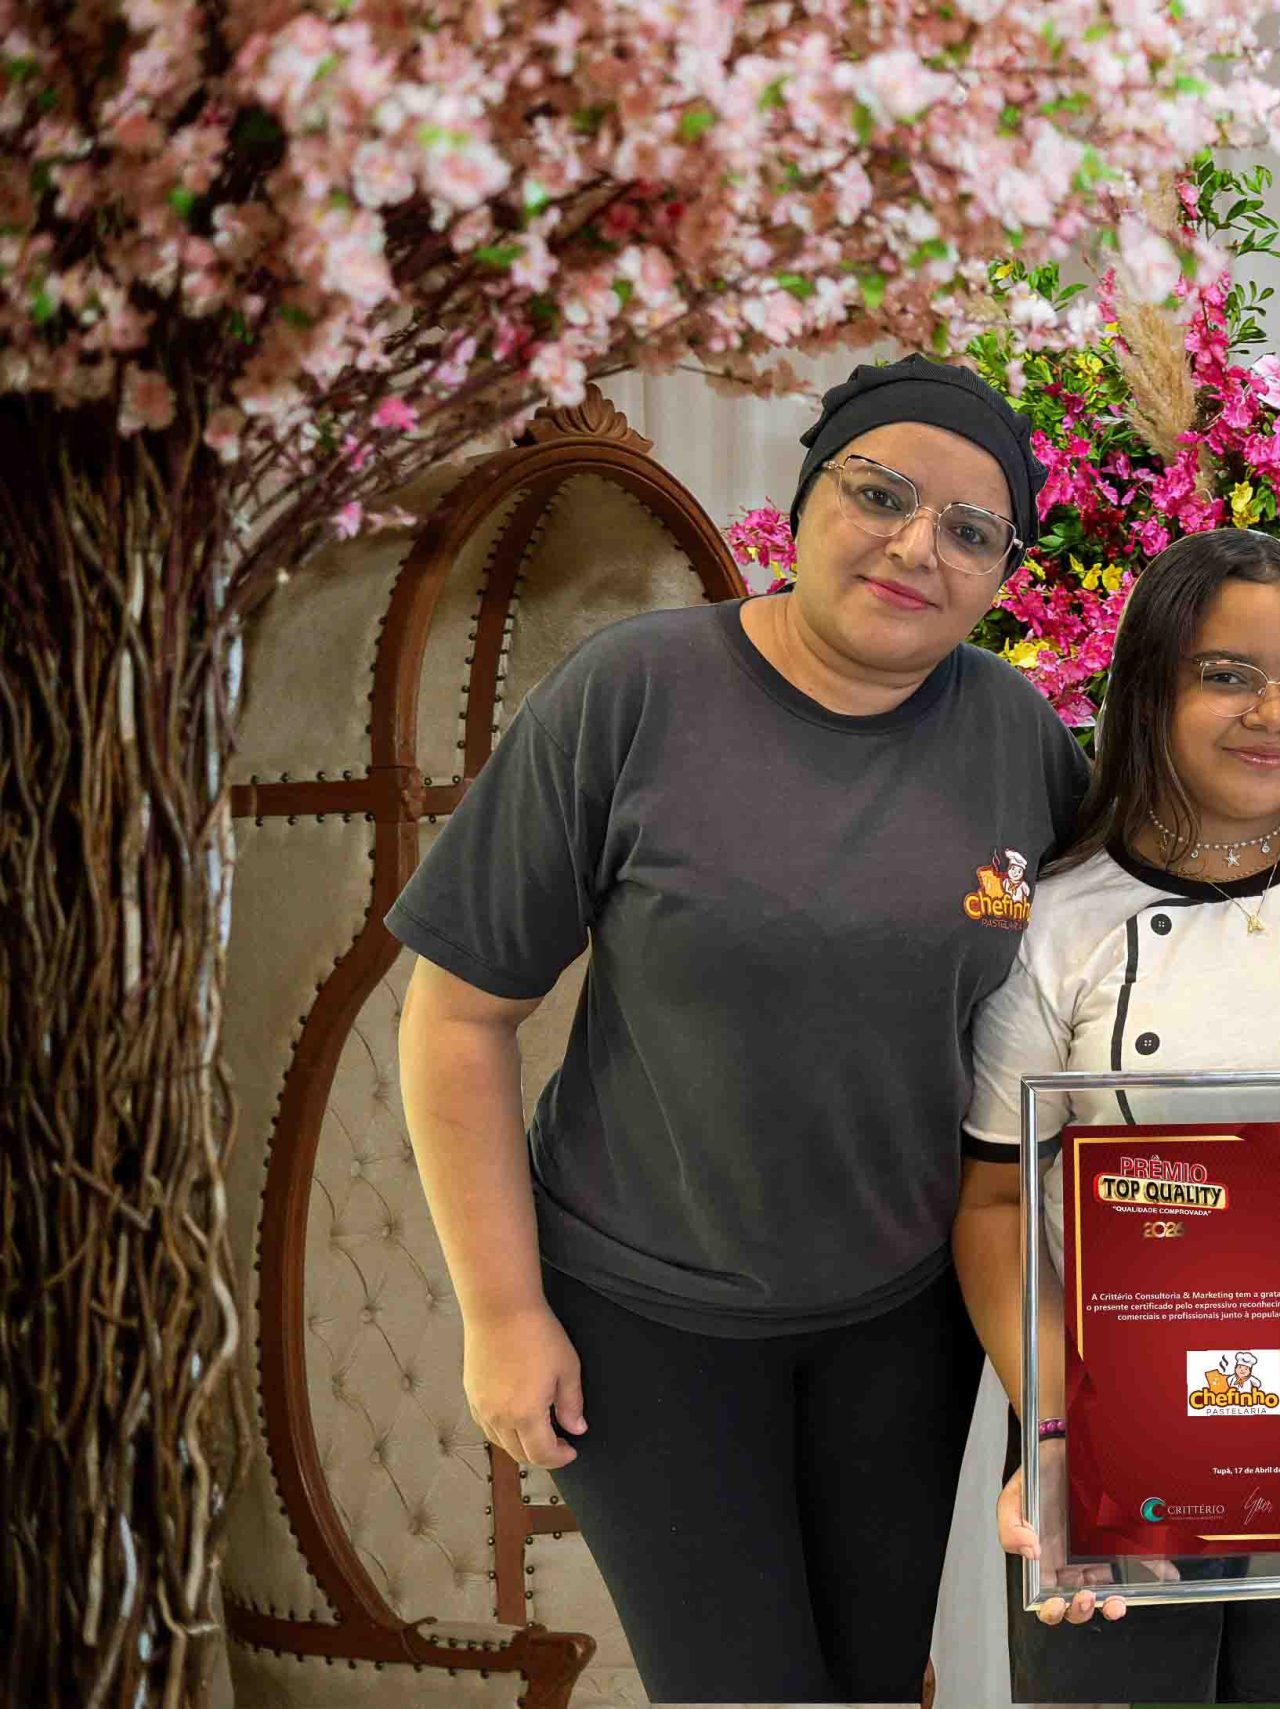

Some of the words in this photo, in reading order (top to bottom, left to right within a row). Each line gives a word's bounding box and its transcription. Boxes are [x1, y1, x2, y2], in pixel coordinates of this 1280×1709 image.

[964, 891, 1032, 920] Chefinh
[1120, 1154, 1207, 1184] PRÊMIO
[1102, 1177, 1140, 1200] TOP
[1144, 1181, 1223, 1207] QUALITY
[1143, 1221, 1183, 1238] 2026
[1091, 1293, 1098, 1301] A
[1099, 1293, 1133, 1301] Crittério
[1134, 1292, 1181, 1300] Consultoria
[1183, 1291, 1191, 1299] &
[1192, 1291, 1234, 1301] Marketing
[1260, 1291, 1280, 1301] grata
[1093, 1303, 1129, 1312] presente
[1130, 1302, 1173, 1310] certificado
[1175, 1302, 1193, 1312] pelo
[1194, 1301, 1238, 1311] expressivo
[1117, 1312, 1160, 1320] comerciais
[1168, 1311, 1220, 1320] profissionais
[1220, 1311, 1243, 1320] junto
[1189, 1386, 1279, 1409] Chefinho
[1206, 1407, 1267, 1415] PASTELARIA
[1167, 1504, 1225, 1515] CRITTÉRIO
